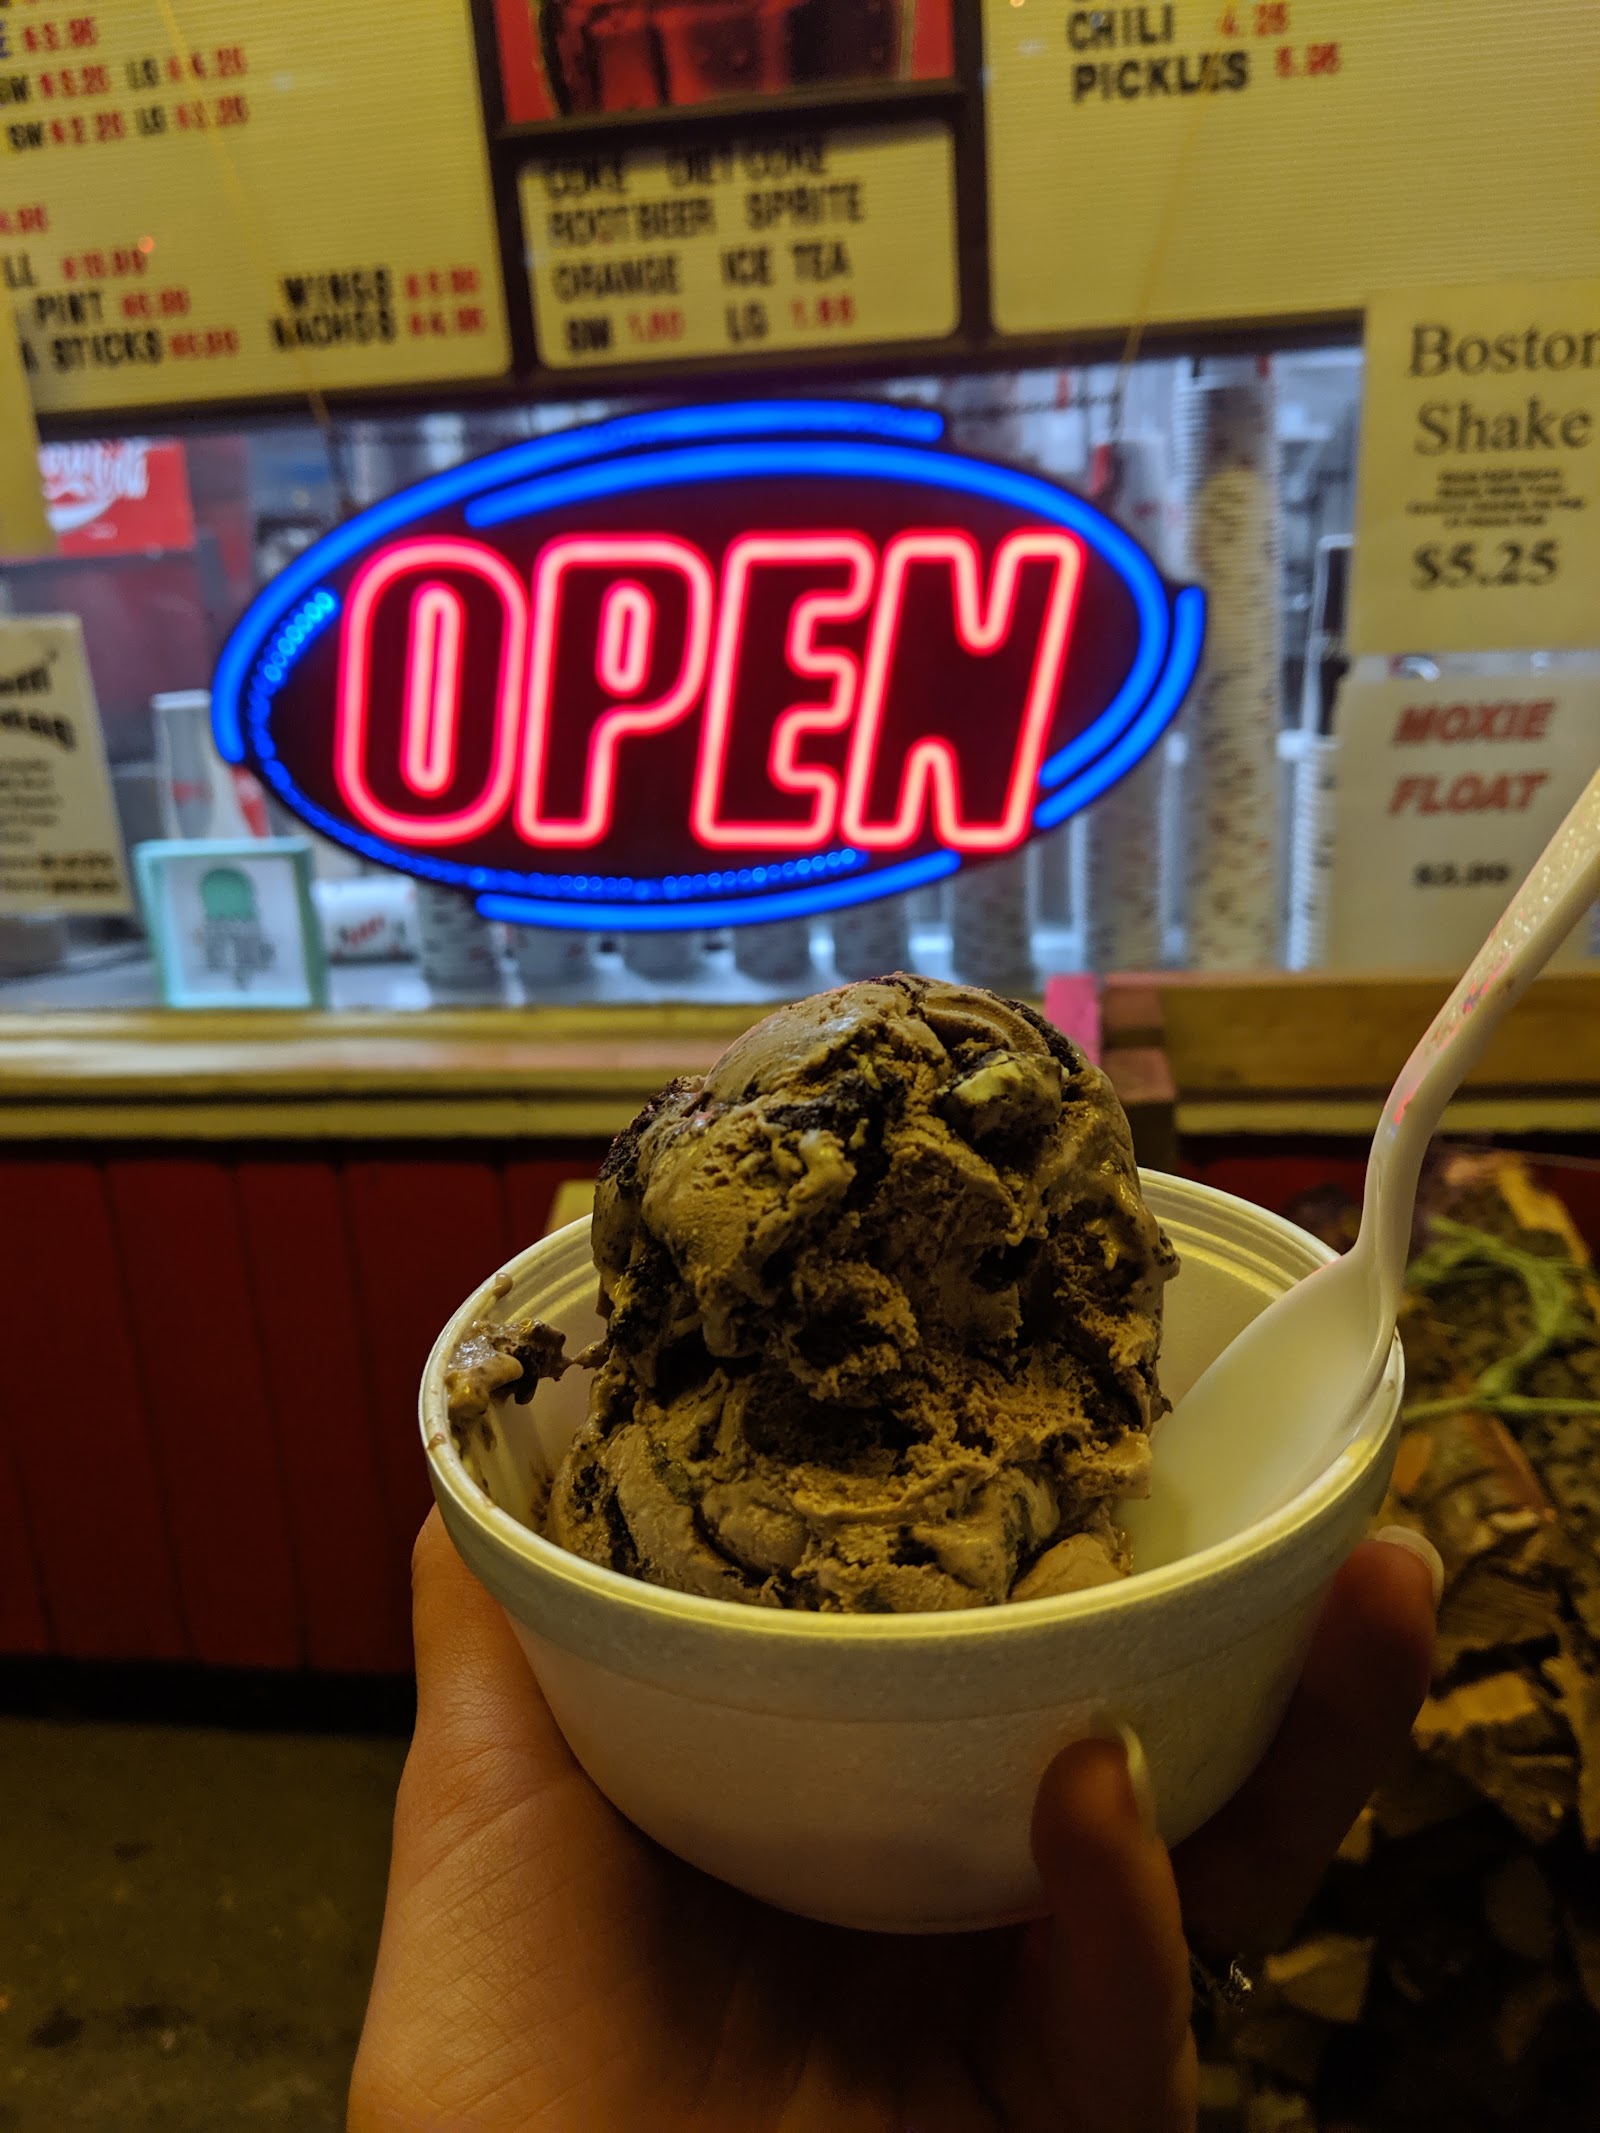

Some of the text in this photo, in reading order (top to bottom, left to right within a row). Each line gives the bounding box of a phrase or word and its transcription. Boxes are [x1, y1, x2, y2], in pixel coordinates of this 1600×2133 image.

[1066, 4, 1174, 51] CHILI
[547, 181, 866, 248] ROOT BEER SPRITE
[553, 240, 852, 302] ORANGE ICE TEA
[53, 328, 163, 374] STICKS
[1414, 394, 1592, 456] Shake
[1411, 539, 1559, 590] $5.25
[333, 529, 1083, 853] OPEN
[1391, 697, 1556, 746] MOXIE
[1388, 769, 1551, 818] FLOAT
